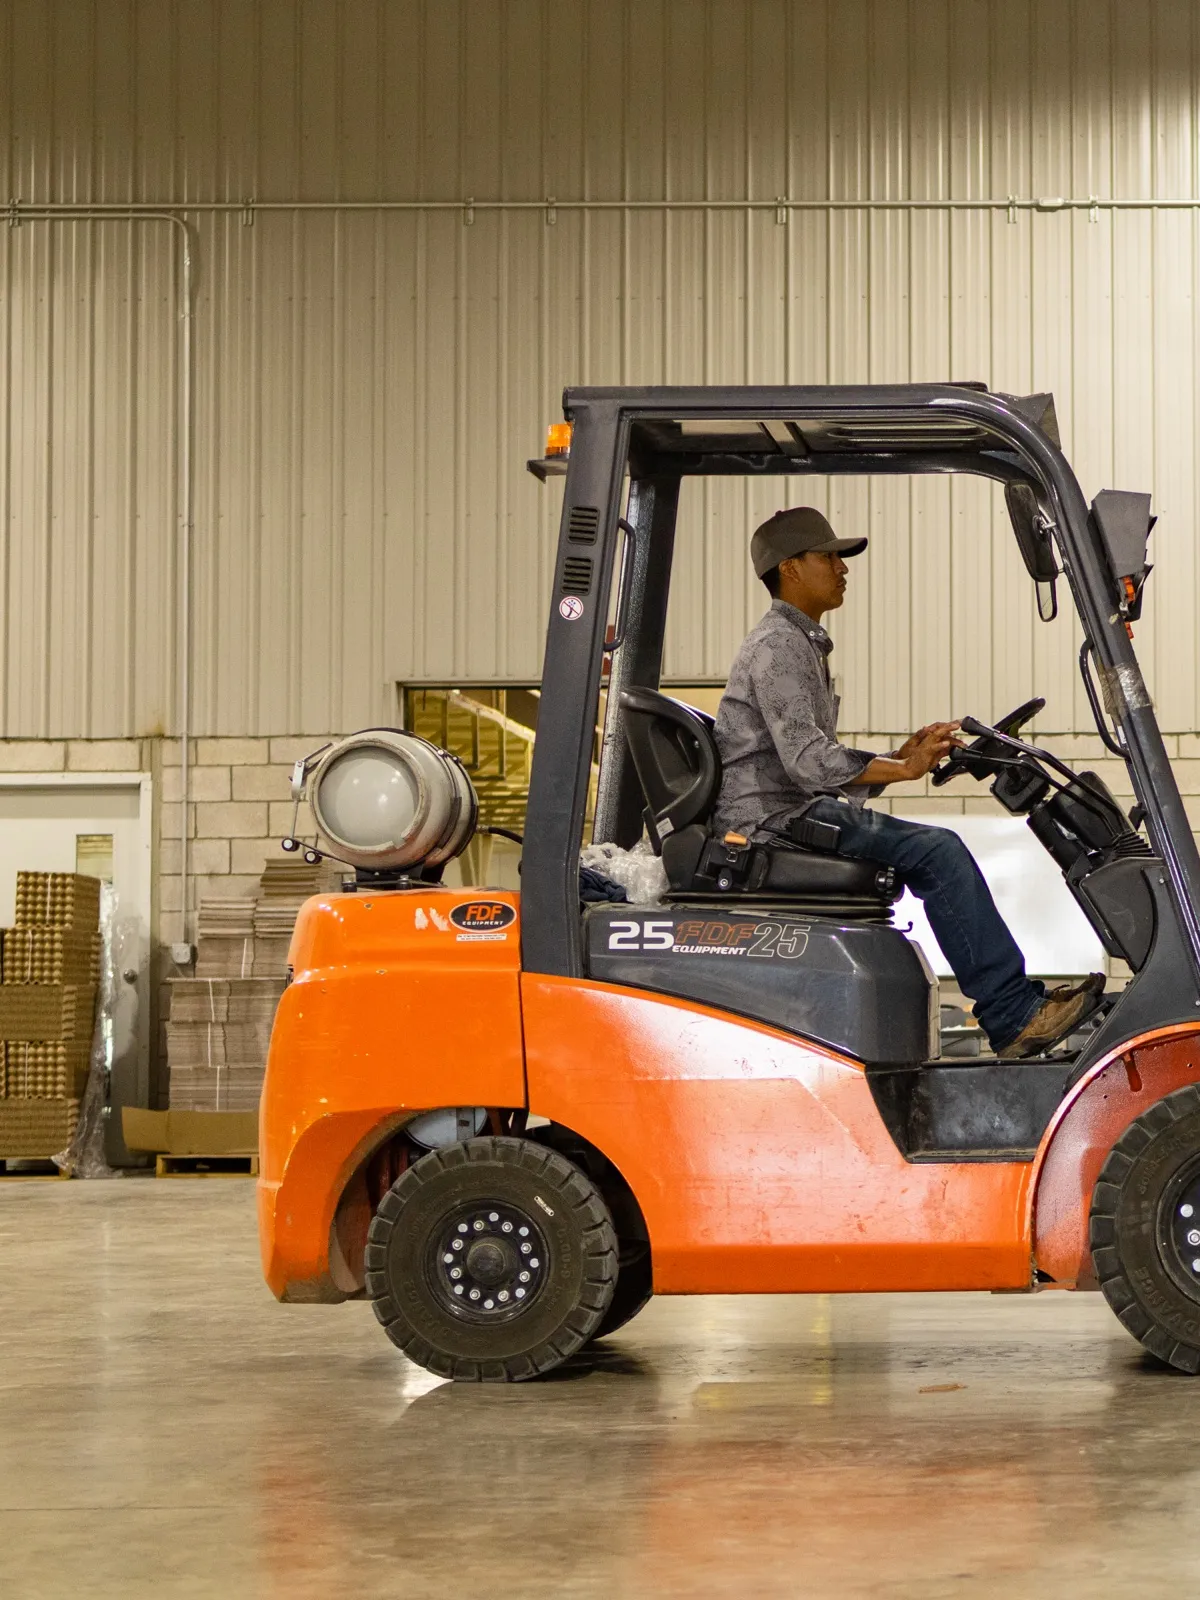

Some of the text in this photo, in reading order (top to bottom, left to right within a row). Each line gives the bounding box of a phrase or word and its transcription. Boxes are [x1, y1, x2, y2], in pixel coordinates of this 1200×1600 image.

[466, 905, 502, 920] FDF
[608, 920, 811, 959] 25 FDF 25
[672, 945, 746, 955] EQUIPMENT
